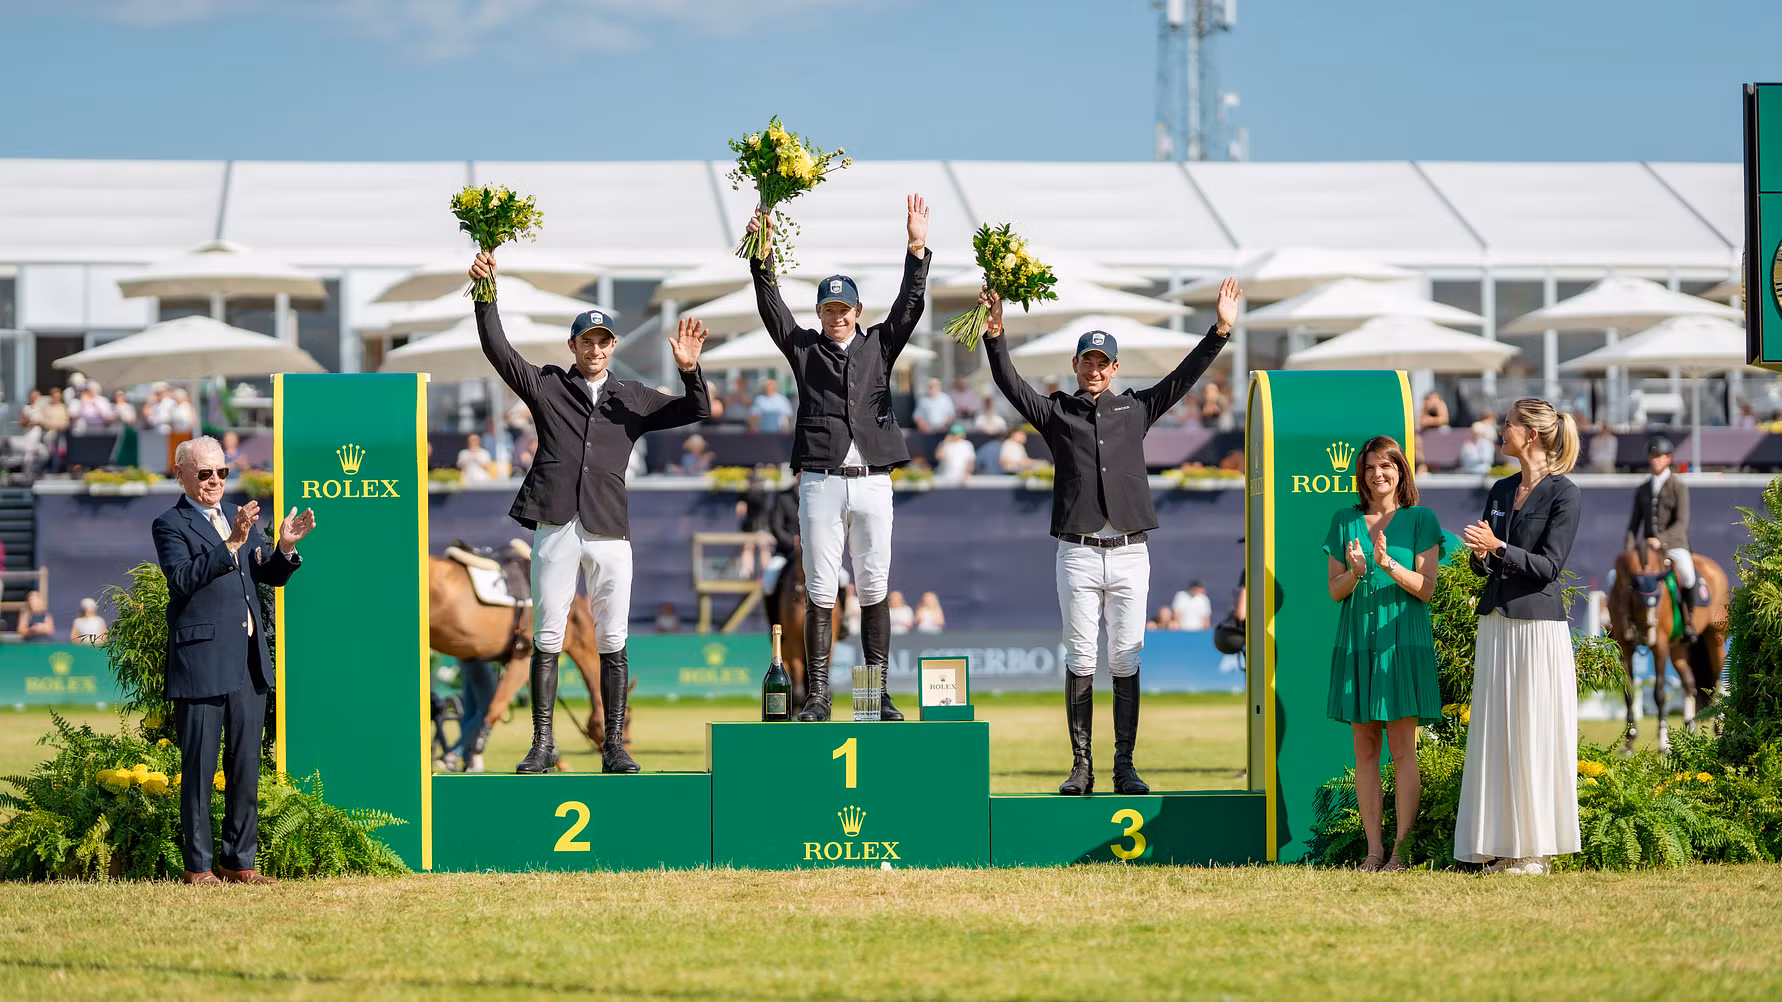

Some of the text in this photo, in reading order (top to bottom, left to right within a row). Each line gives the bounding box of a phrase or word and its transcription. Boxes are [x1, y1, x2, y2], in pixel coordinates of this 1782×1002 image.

[301, 479, 401, 499] ROLEX
[1291, 474, 1359, 493] ROL
[832, 737, 857, 789] 1
[553, 800, 591, 852] 2
[1110, 808, 1147, 860] 3
[803, 841, 901, 860] ROLEX
